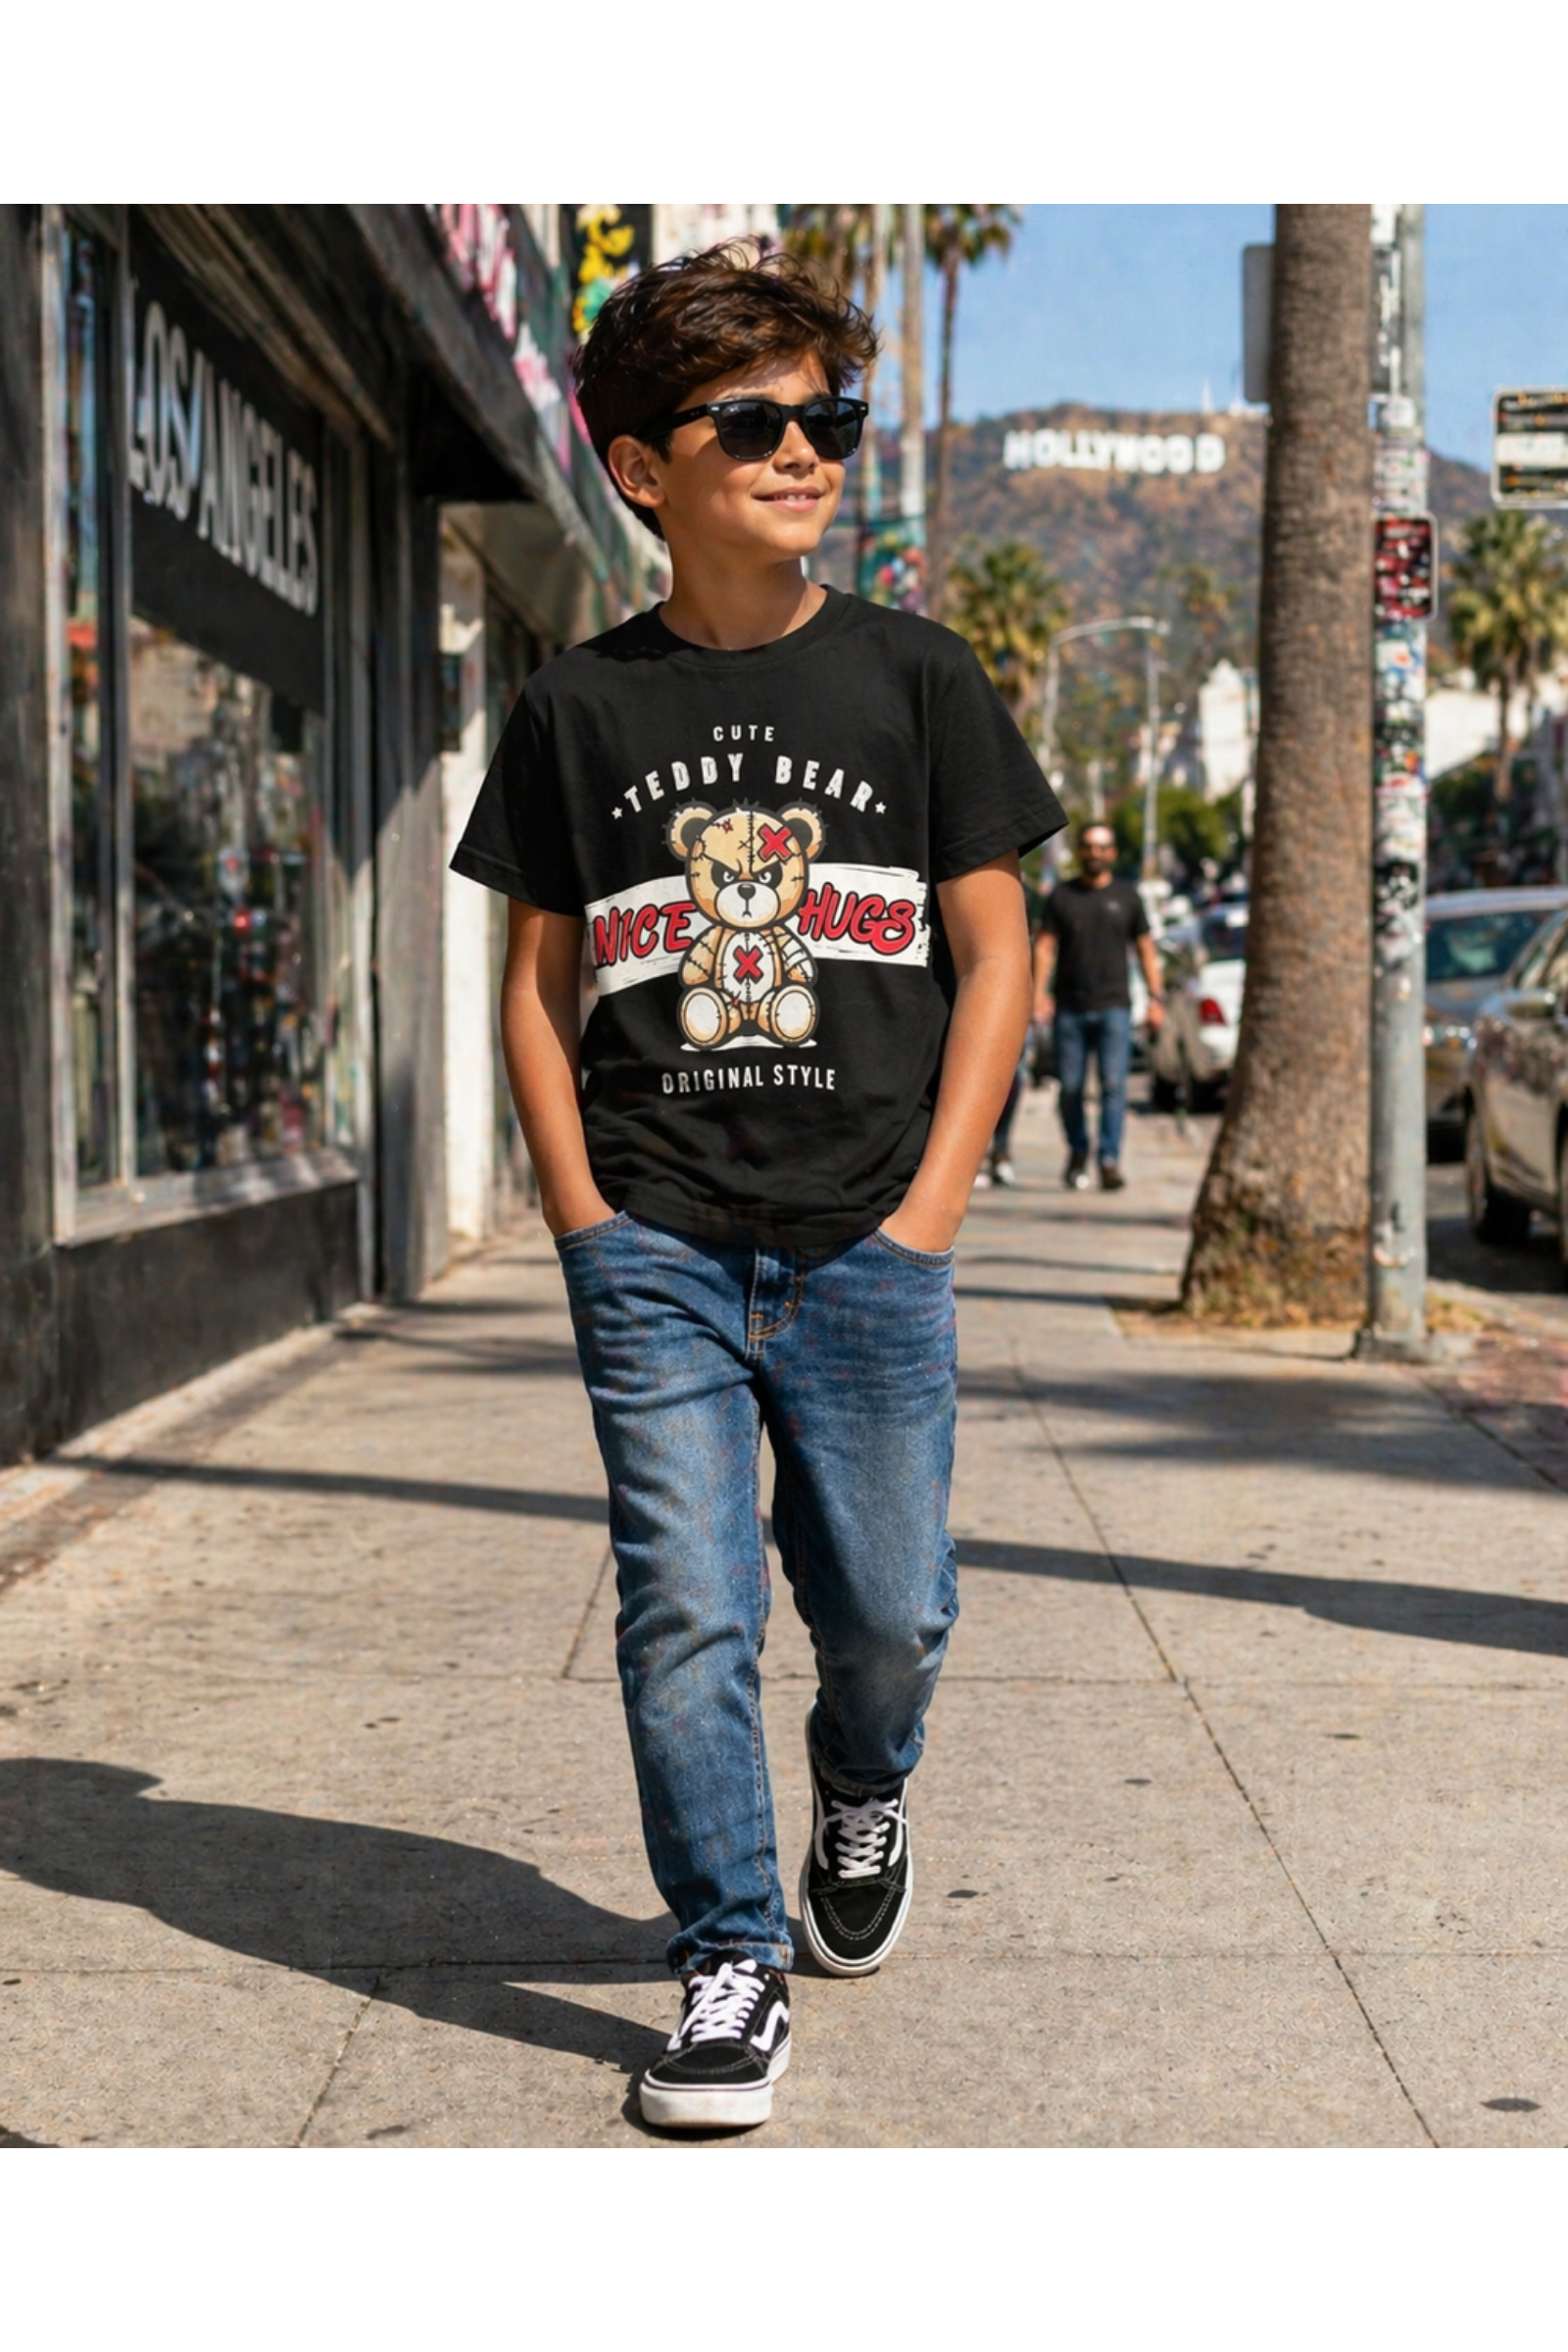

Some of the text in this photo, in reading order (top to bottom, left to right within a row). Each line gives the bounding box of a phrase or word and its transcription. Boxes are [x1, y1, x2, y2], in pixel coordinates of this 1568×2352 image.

[126, 300, 319, 617] LOS ANGELES
[1004, 428, 1225, 474] HOLLYWOOD
[712, 724, 775, 742] CUTE
[623, 753, 874, 812] TEDDY BEAR
[593, 882, 916, 966] NICE HUGS
[662, 1063, 836, 1095] ORIGINAL STYLE
